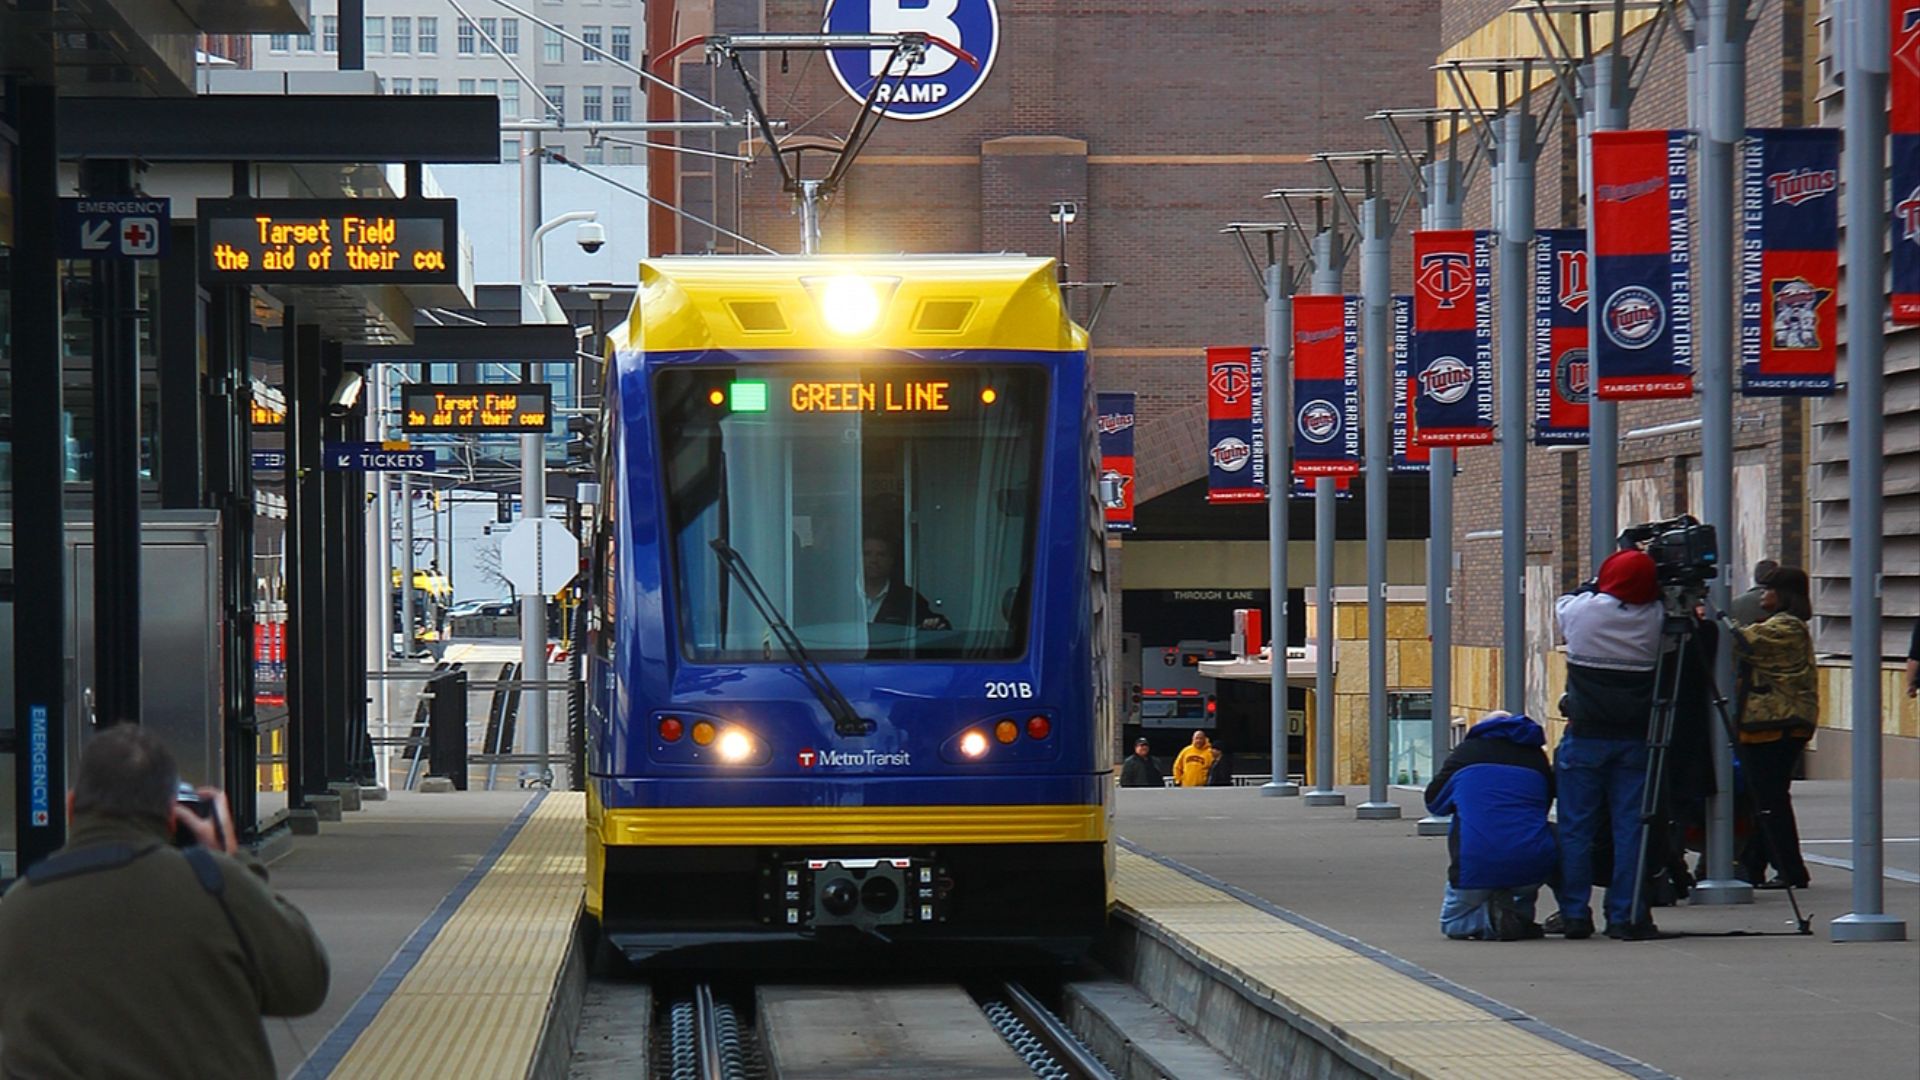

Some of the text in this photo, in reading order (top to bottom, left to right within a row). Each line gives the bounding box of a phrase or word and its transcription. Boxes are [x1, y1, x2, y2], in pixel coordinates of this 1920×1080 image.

[875, 83, 949, 103] RAMP
[1767, 168, 1837, 206] Twins
[77, 202, 165, 213] EMERGENCY
[255, 217, 397, 245] Target Field
[213, 244, 250, 271] the
[263, 244, 295, 271] aid
[308, 246, 333, 271] of
[346, 244, 401, 271] their
[1668, 136, 1692, 368] THIS IS TWINS TERRITORY
[1743, 135, 1764, 366] THIS IS TWINS TERRITORY
[1475, 234, 1493, 421] THIS IS TWINS TERRITORY
[1536, 235, 1552, 421] THIS IS TWINS TERRITORY
[1344, 300, 1359, 456] THIS IS TWINS TERRITORY
[1394, 300, 1409, 455] THIS IS TWINS TERRITORY
[1419, 363, 1473, 396] Twins
[1604, 382, 1686, 392] TARGET FIELD
[435, 394, 517, 411] Target Field
[791, 383, 949, 411] GREEN LINE
[432, 410, 452, 425] aid
[459, 411, 473, 425] of
[481, 411, 512, 425] their
[1251, 351, 1264, 484] THIS IS TWINS TERRITORY
[360, 454, 424, 468] TICKETS
[1210, 444, 1250, 467] Twins
[1174, 591, 1254, 600] THROUGH LANE
[985, 682, 1033, 699] 201B
[32, 708, 47, 807] EMERGENCY
